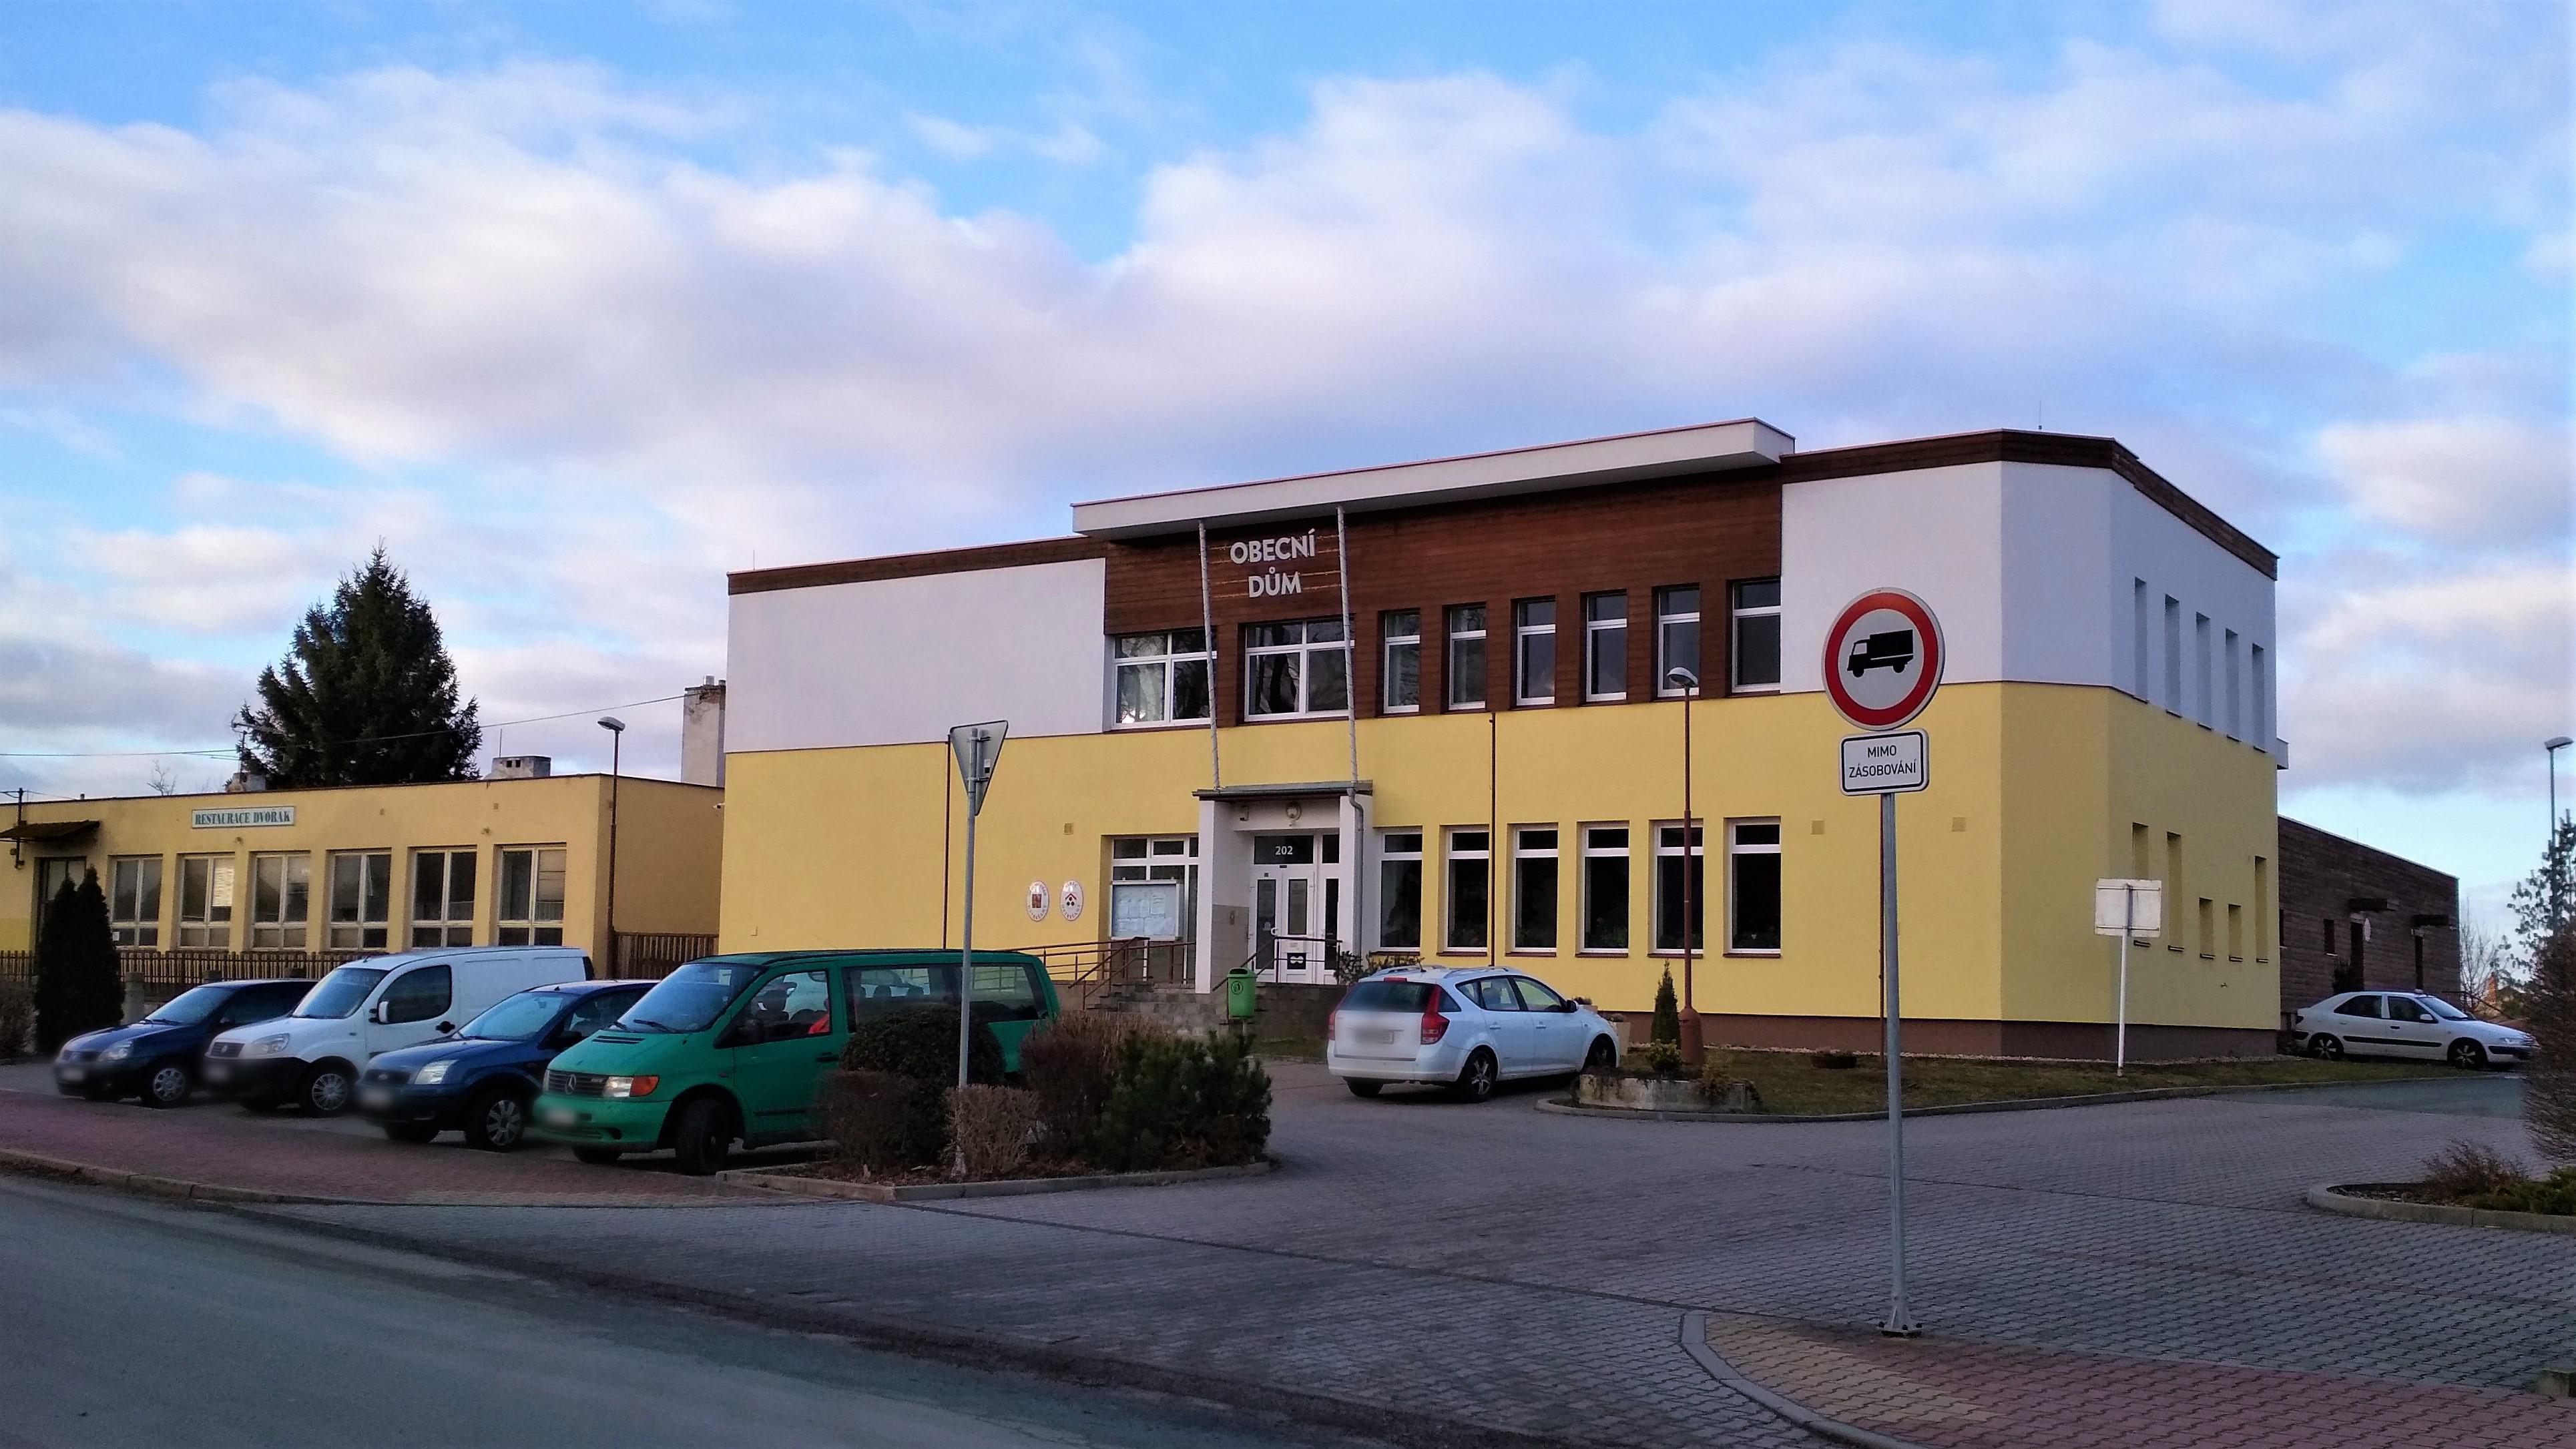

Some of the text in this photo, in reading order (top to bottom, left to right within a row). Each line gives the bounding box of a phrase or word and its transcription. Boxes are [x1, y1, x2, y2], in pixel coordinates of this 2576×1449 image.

[1230, 528, 1315, 564] OBECNÍ
[1248, 567, 1301, 597] DŮM
[1867, 745, 1897, 758] MIMO
[1848, 759, 1916, 778] ZÁSOBOVÁNÍ
[195, 812, 250, 825] RESTAURACE
[1275, 846, 1293, 855] 202
